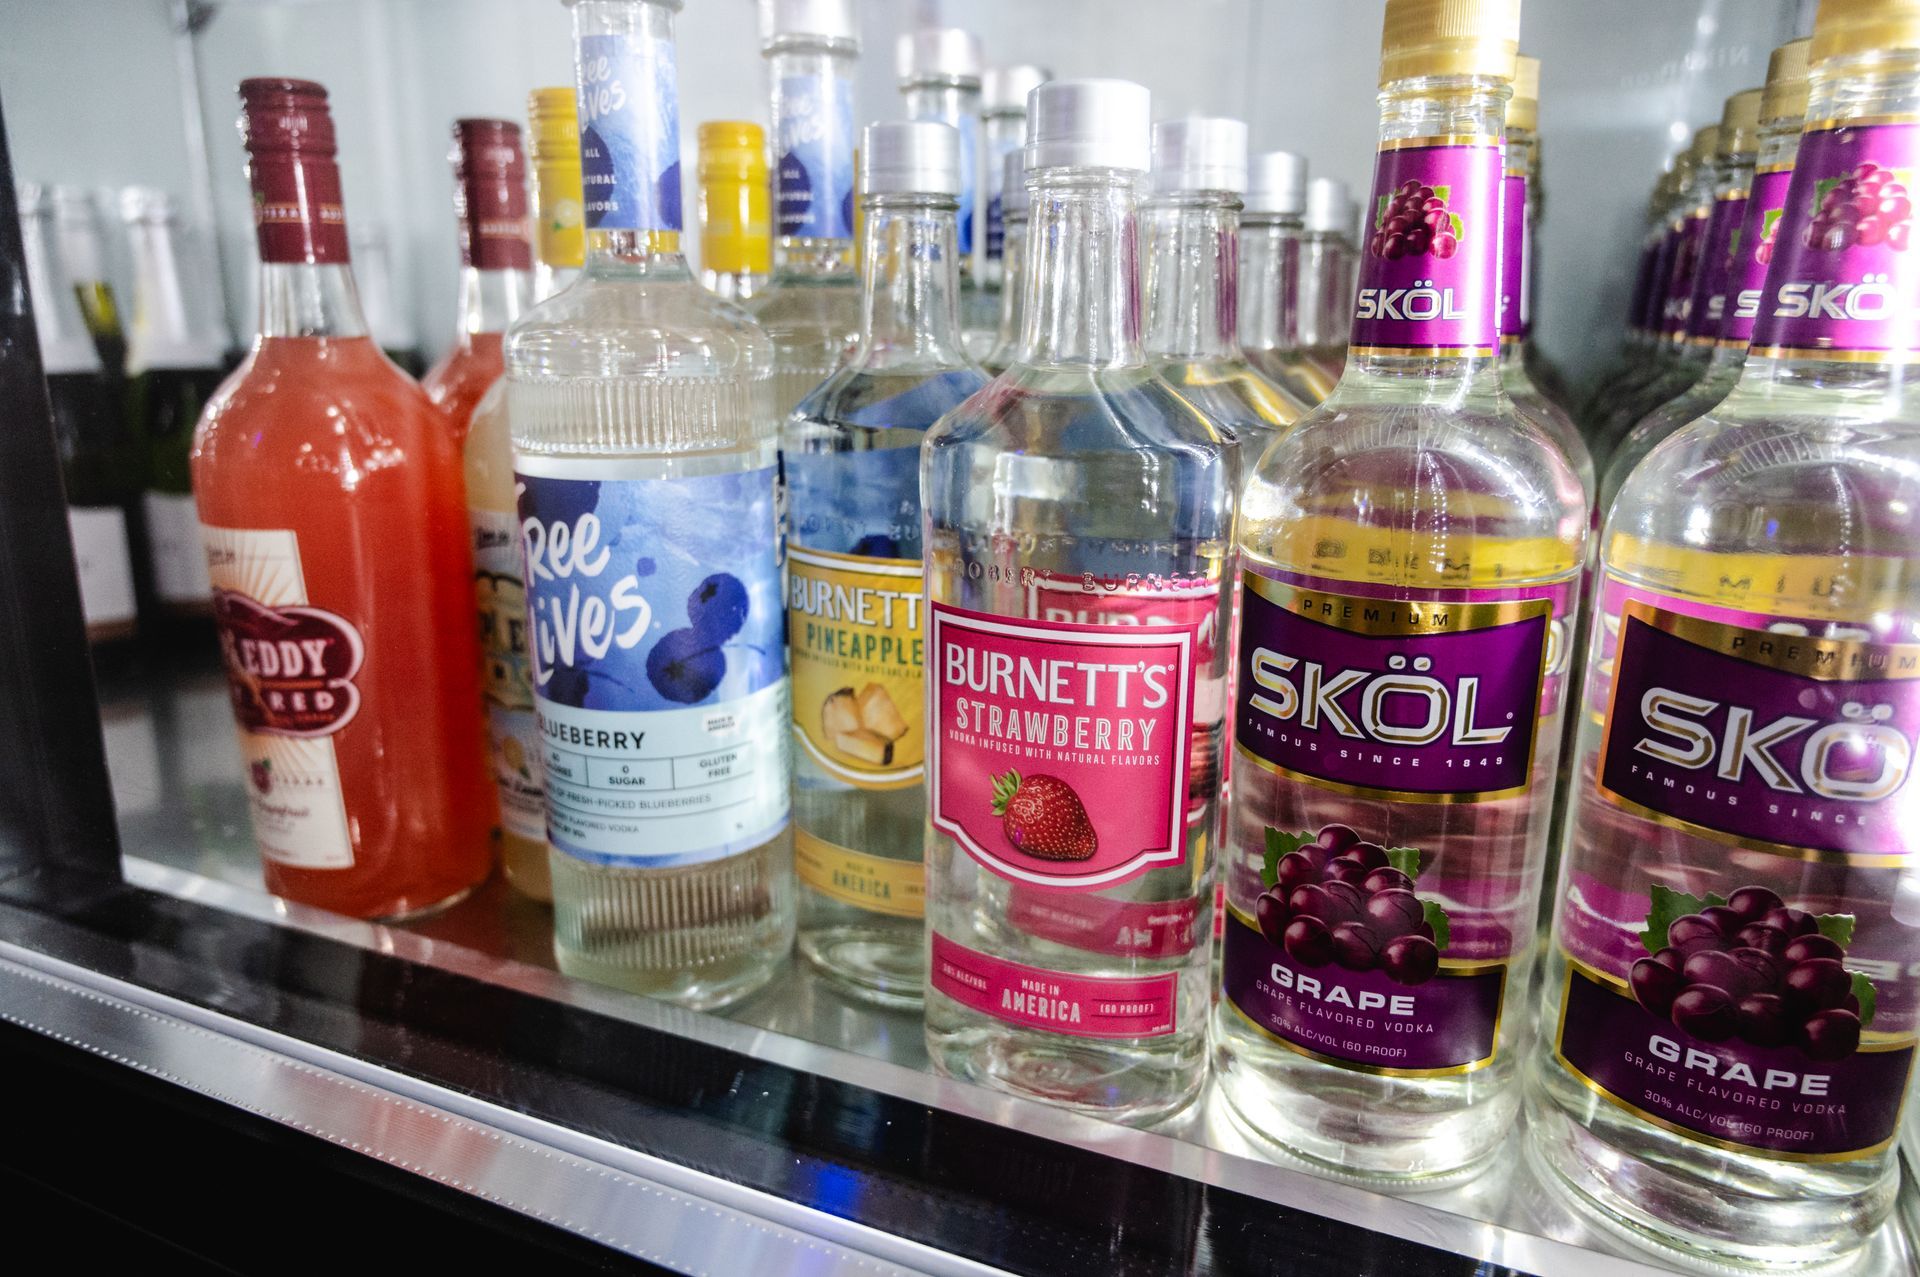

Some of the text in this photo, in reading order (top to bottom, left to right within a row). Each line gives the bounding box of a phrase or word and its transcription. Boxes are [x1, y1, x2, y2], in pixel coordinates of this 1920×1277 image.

[1356, 279, 1467, 321] SKÖL
[1772, 273, 1900, 321] SKÖ
[791, 575, 923, 630] BURNETT
[1303, 599, 1450, 627] PREMIUM
[807, 622, 923, 666] PINEAPPLE
[1732, 636, 1919, 670] PREMIUM
[945, 642, 1169, 710] BURNETT'S
[1249, 646, 1514, 746] SKÖL
[270, 690, 335, 711] RED
[956, 696, 1158, 751] STRAWBERRY
[1248, 718, 1503, 769] FAMOUS SINCE 1849
[1632, 686, 1912, 802] SKÖ
[699, 752, 738, 768] GLUTEN
[950, 729, 1160, 767] VODKA INFUSED WITH NATURAL FLAVORS
[608, 775, 646, 786] SUGAR
[708, 766, 731, 778] FREE
[639, 793, 712, 809] BLUEBERRIES
[1631, 765, 1867, 826] FAMOUS SINCE
[608, 824, 640, 834] VODKA
[832, 867, 892, 899] AMERICA
[1001, 988, 1082, 1024] AMERICA
[1021, 979, 1061, 996] MADE IN
[1256, 979, 1434, 1034] GRAPE FLAVORED VODKA
[1270, 962, 1416, 1017] GRAPE
[1270, 1013, 1408, 1058] 30% ALC/VOL (60 PROOF)
[1624, 1050, 1847, 1115] GRAPE FLAVORED VODKA
[1648, 1033, 1832, 1097] GRAPE
[1643, 1088, 1673, 1109] 30%
[1676, 1102, 1738, 1130] ALC/VOL
[1766, 1126, 1815, 1142] PROOF)
